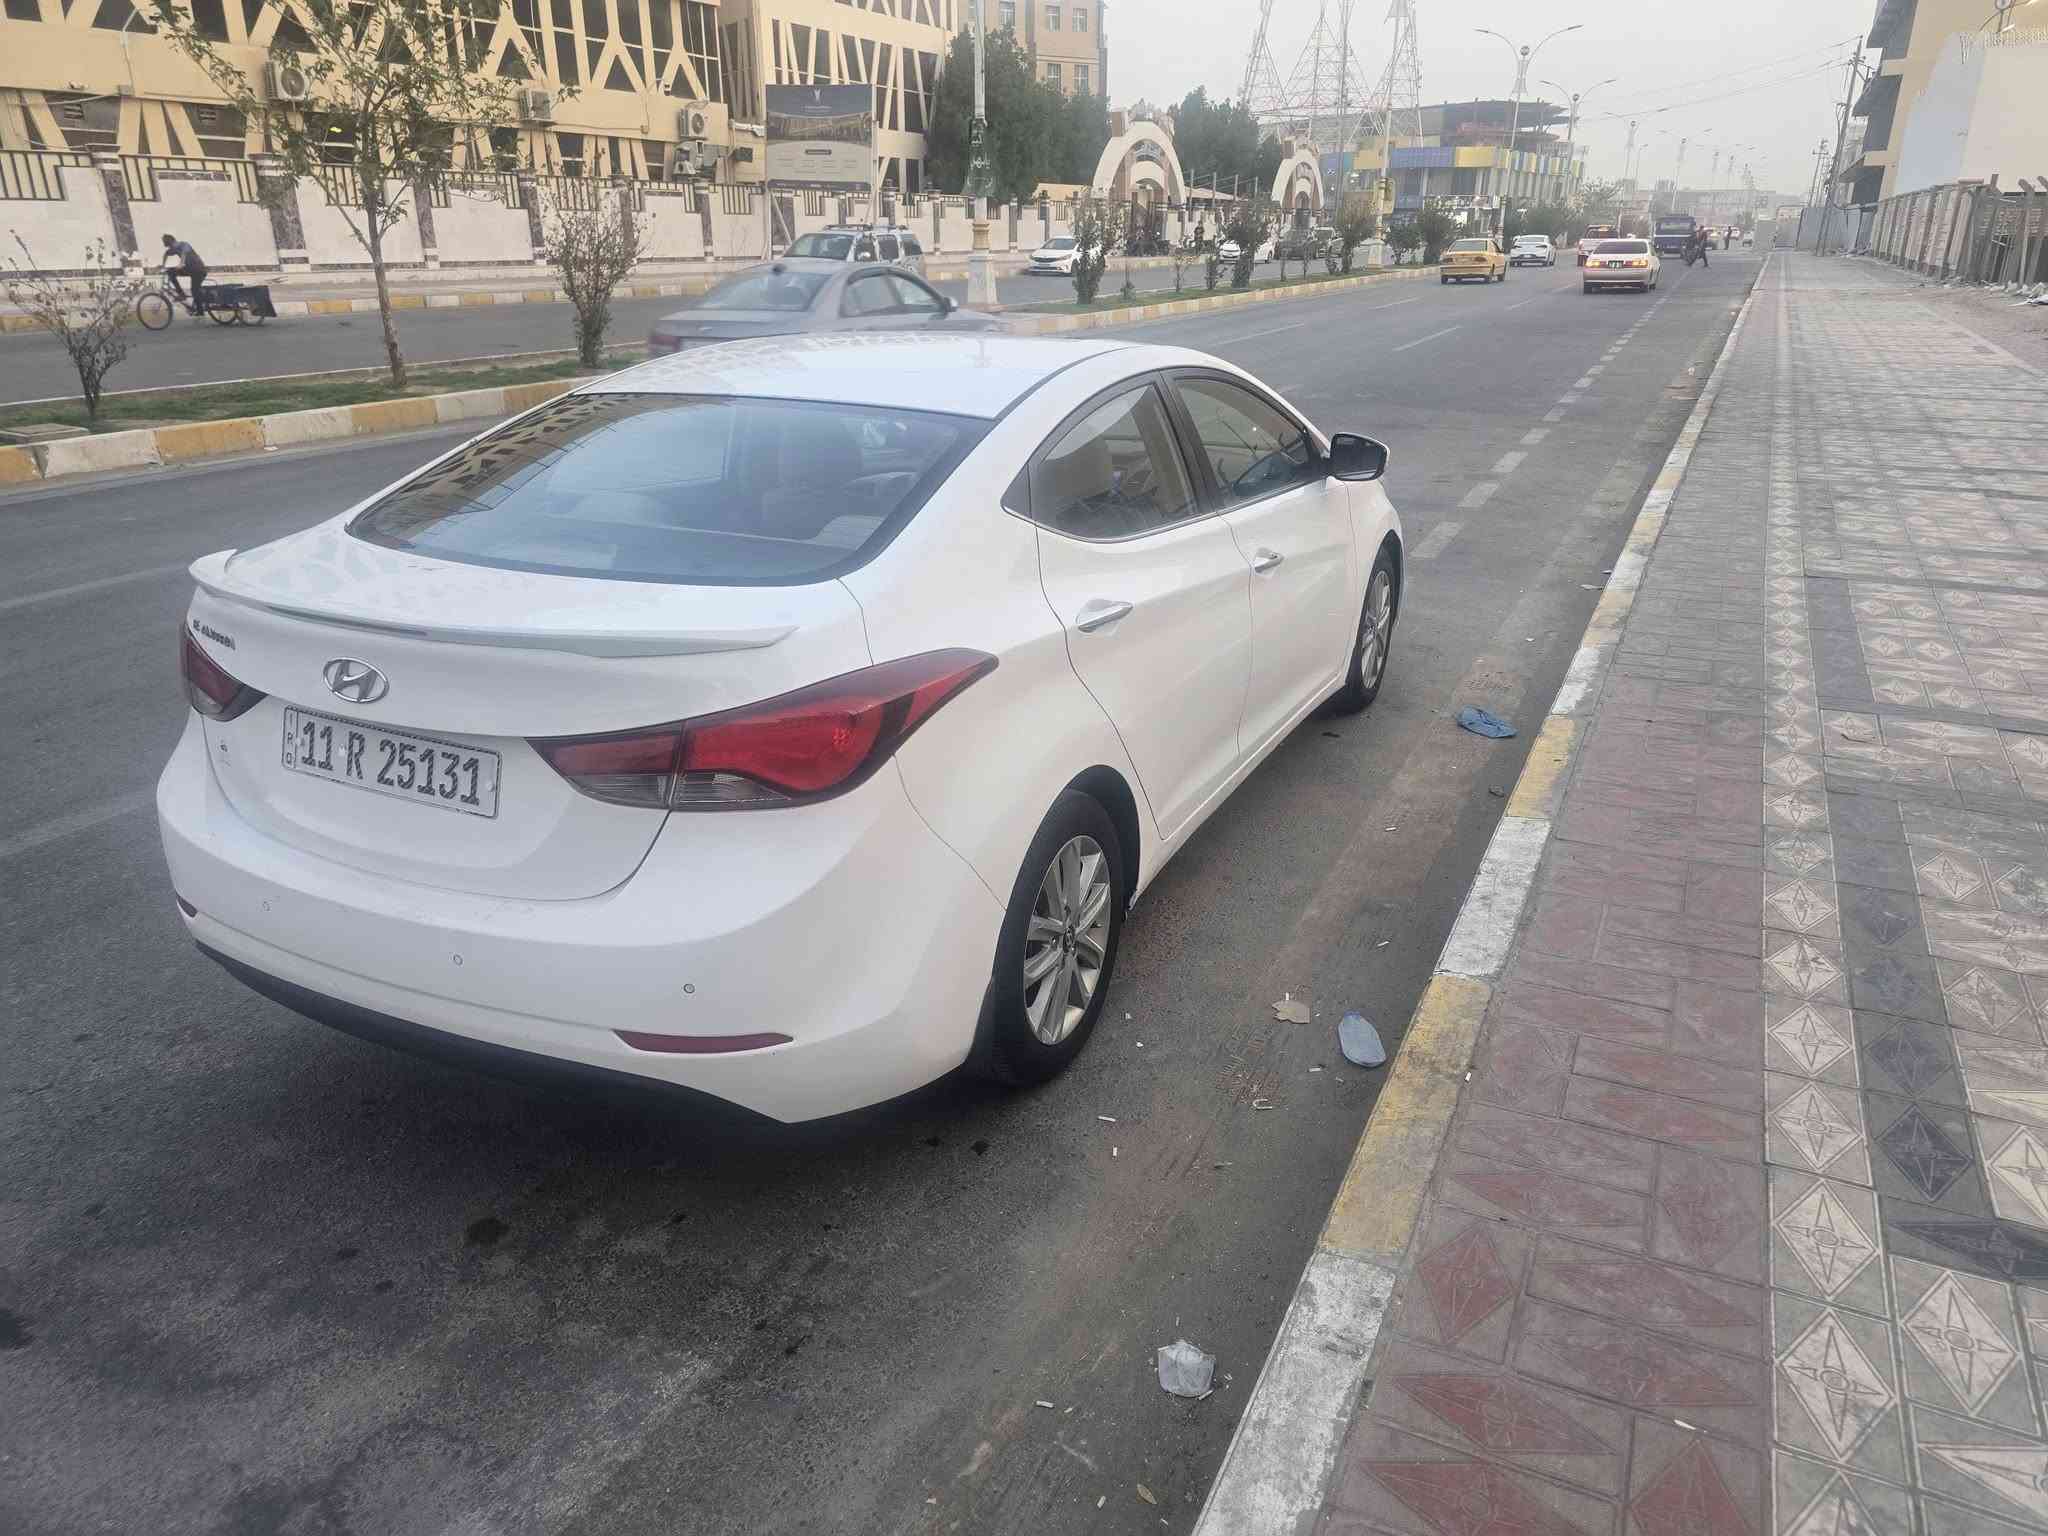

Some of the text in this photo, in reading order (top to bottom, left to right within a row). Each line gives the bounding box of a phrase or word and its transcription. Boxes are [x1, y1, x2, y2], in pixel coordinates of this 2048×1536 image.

[301, 720, 481, 806] 11 R 25131
